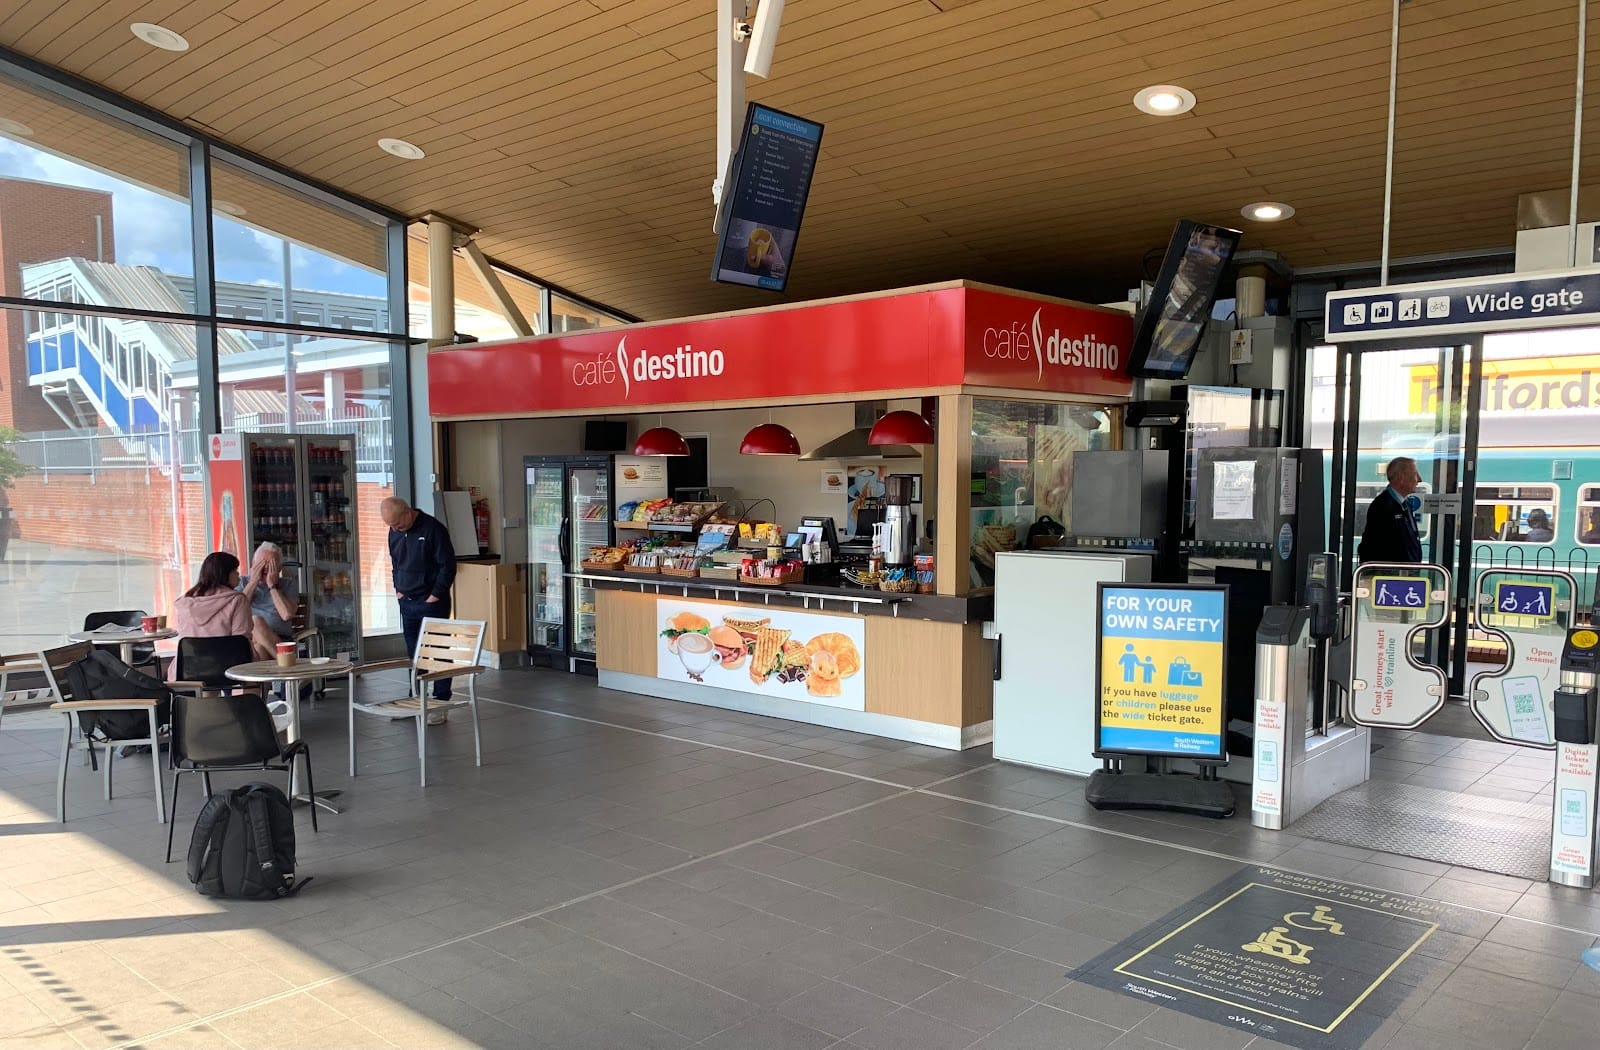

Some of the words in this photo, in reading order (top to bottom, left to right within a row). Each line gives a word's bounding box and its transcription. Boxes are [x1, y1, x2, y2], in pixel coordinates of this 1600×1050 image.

[772, 118, 808, 134] connections
[1466, 292, 1523, 313] Wide
[1531, 288, 1584, 314] gate
[984, 322, 1029, 360] café
[1047, 329, 1118, 370] destino
[573, 352, 616, 386] café
[633, 345, 724, 382] destino
[1107, 596, 1139, 611] FOR
[1145, 598, 1192, 612] YOUR
[1106, 615, 1147, 629] OWN
[1152, 617, 1220, 632] SAFETY
[1386, 638, 1395, 674] trainline
[1531, 648, 1552, 656] Open
[1374, 652, 1386, 689] journeys
[1113, 690, 1130, 700] you
[1134, 688, 1157, 698] have
[1160, 690, 1198, 702] luggage
[1372, 691, 1382, 715] Great
[1384, 689, 1392, 708] with
[1116, 699, 1156, 709] children
[1159, 702, 1191, 713] please
[1261, 705, 1278, 713] Digital
[1103, 710, 1119, 718] the
[1122, 711, 1145, 720] wide
[1148, 712, 1176, 722] ticket
[1180, 715, 1204, 725] gate.
[1565, 747, 1588, 756] Digital
[1259, 868, 1348, 893] Wheelchair
[1352, 888, 1386, 900] and
[1390, 896, 1464, 916] mobility
[1273, 878, 1337, 895] scooter
[1339, 892, 1378, 904] user
[1381, 901, 1433, 915] guide
[1191, 950, 1242, 967] mobility
[1244, 965, 1291, 980] scooter
[1296, 977, 1318, 987] fits
[1205, 947, 1233, 957] your
[1235, 954, 1306, 977] wheelchair
[1175, 952, 1211, 965] inside
[1214, 963, 1237, 973] this
[1240, 970, 1263, 981] box
[1266, 977, 1297, 989] they
[1299, 987, 1323, 996] will
[1191, 964, 1206, 972] on
[1244, 979, 1266, 987] our
[1268, 984, 1309, 1001] trains.
[1128, 983, 1147, 992] South
[1148, 989, 1176, 1000] Western
[1235, 984, 1271, 998] 120cm)
